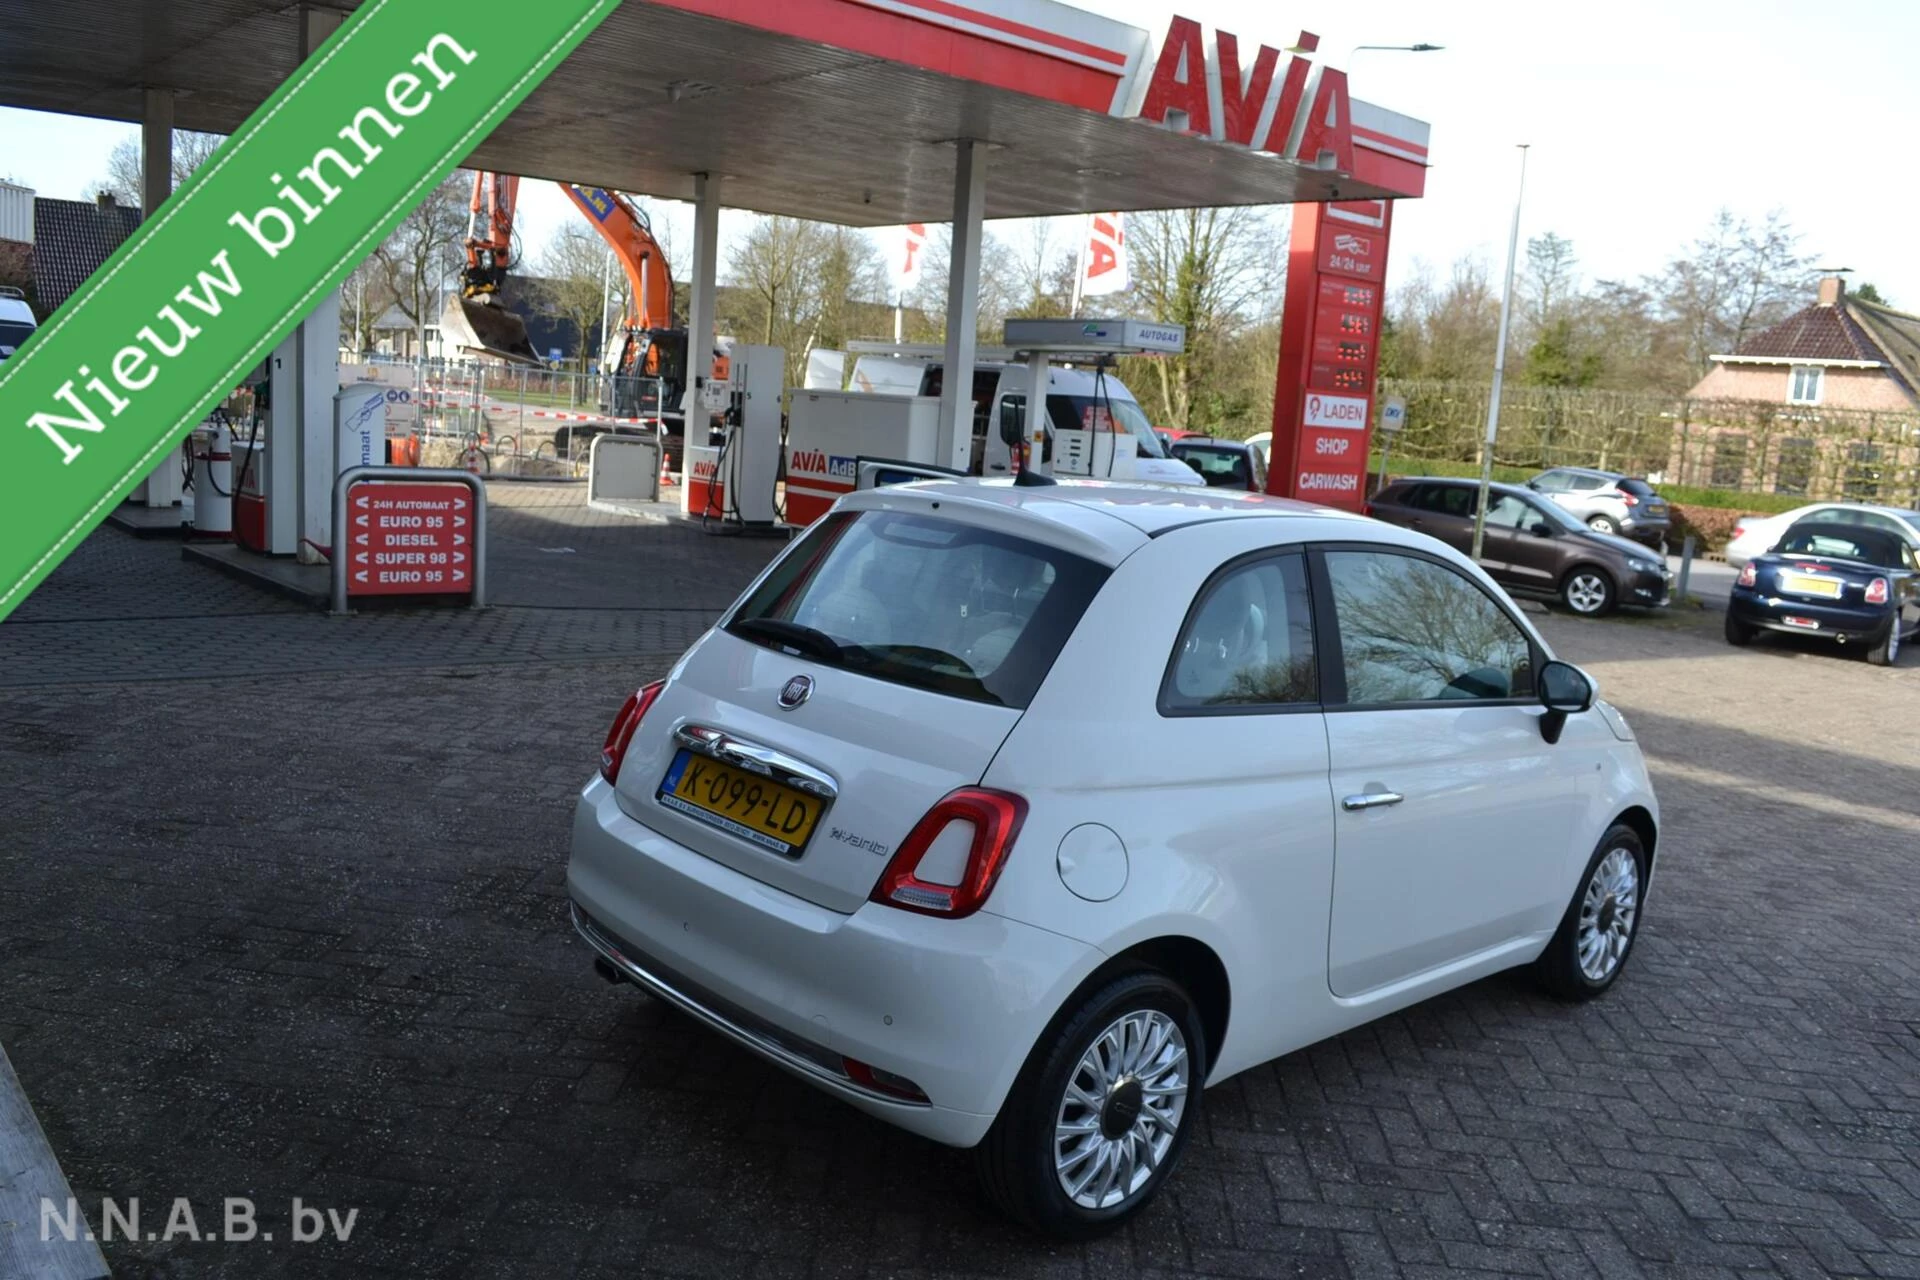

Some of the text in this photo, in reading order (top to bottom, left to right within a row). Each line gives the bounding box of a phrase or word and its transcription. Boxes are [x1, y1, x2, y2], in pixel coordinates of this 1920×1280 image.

[1140, 14, 1354, 175] AVIA
[1138, 329, 1179, 343] AUTOGAS
[275, 358, 282, 369] 1
[1323, 403, 1363, 421] LADEN
[361, 430, 371, 467] maat
[1315, 437, 1349, 455] SHOP
[791, 448, 857, 477] AVIA AdB
[1300, 472, 1358, 491] CARWASH
[373, 501, 450, 510] 24H AUTOMAAT
[380, 516, 443, 528] EURO 95
[385, 535, 438, 546] DIESEL
[375, 553, 447, 565] SUPER 98
[379, 571, 443, 583] EURO 95
[784, 682, 808, 700] FIAT
[683, 762, 807, 835] K-099-LD
